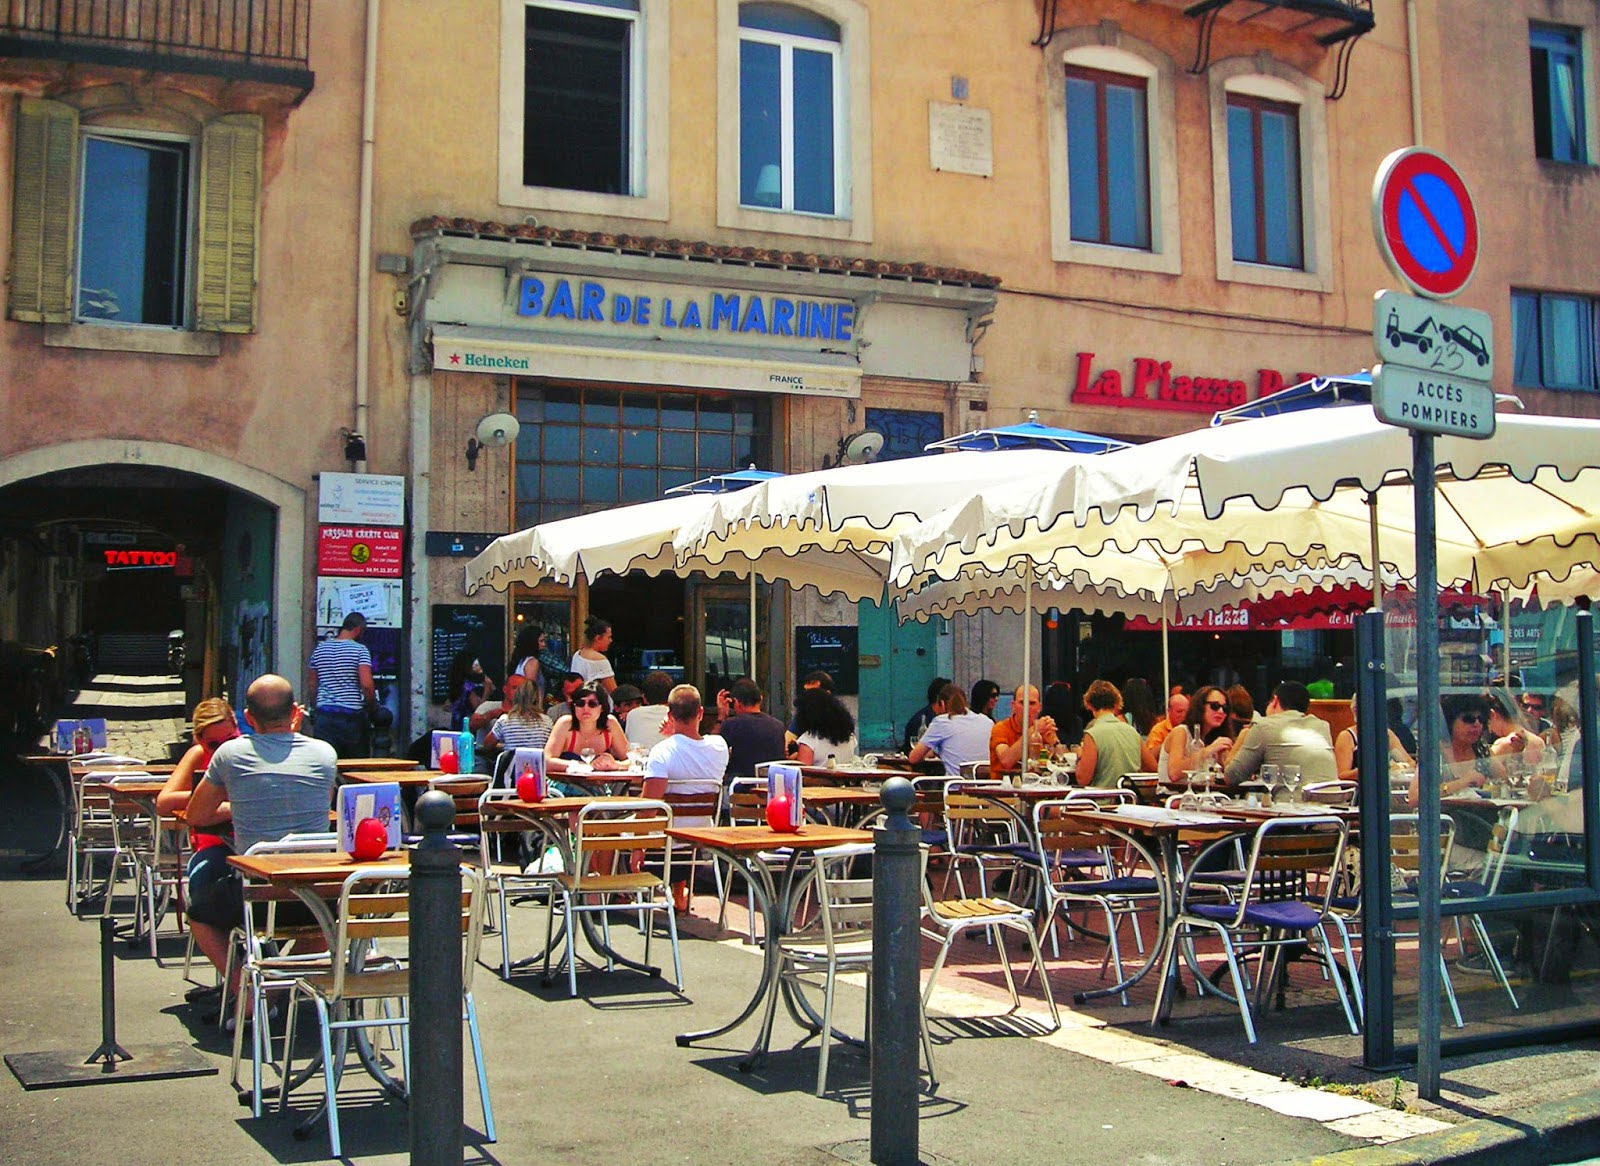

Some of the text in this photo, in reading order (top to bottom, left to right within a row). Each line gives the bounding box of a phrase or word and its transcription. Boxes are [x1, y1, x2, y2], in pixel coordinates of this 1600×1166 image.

[517, 275, 853, 341] BAR DE LA MARINE
[465, 353, 528, 369] Heineken
[769, 375, 803, 384] FRANCE
[1075, 352, 1122, 398] La
[1133, 357, 1247, 404] Piazza
[1402, 402, 1478, 429] POMPIERS
[104, 549, 176, 566] TATTOO
[1526, 628, 1540, 638] ARTS
